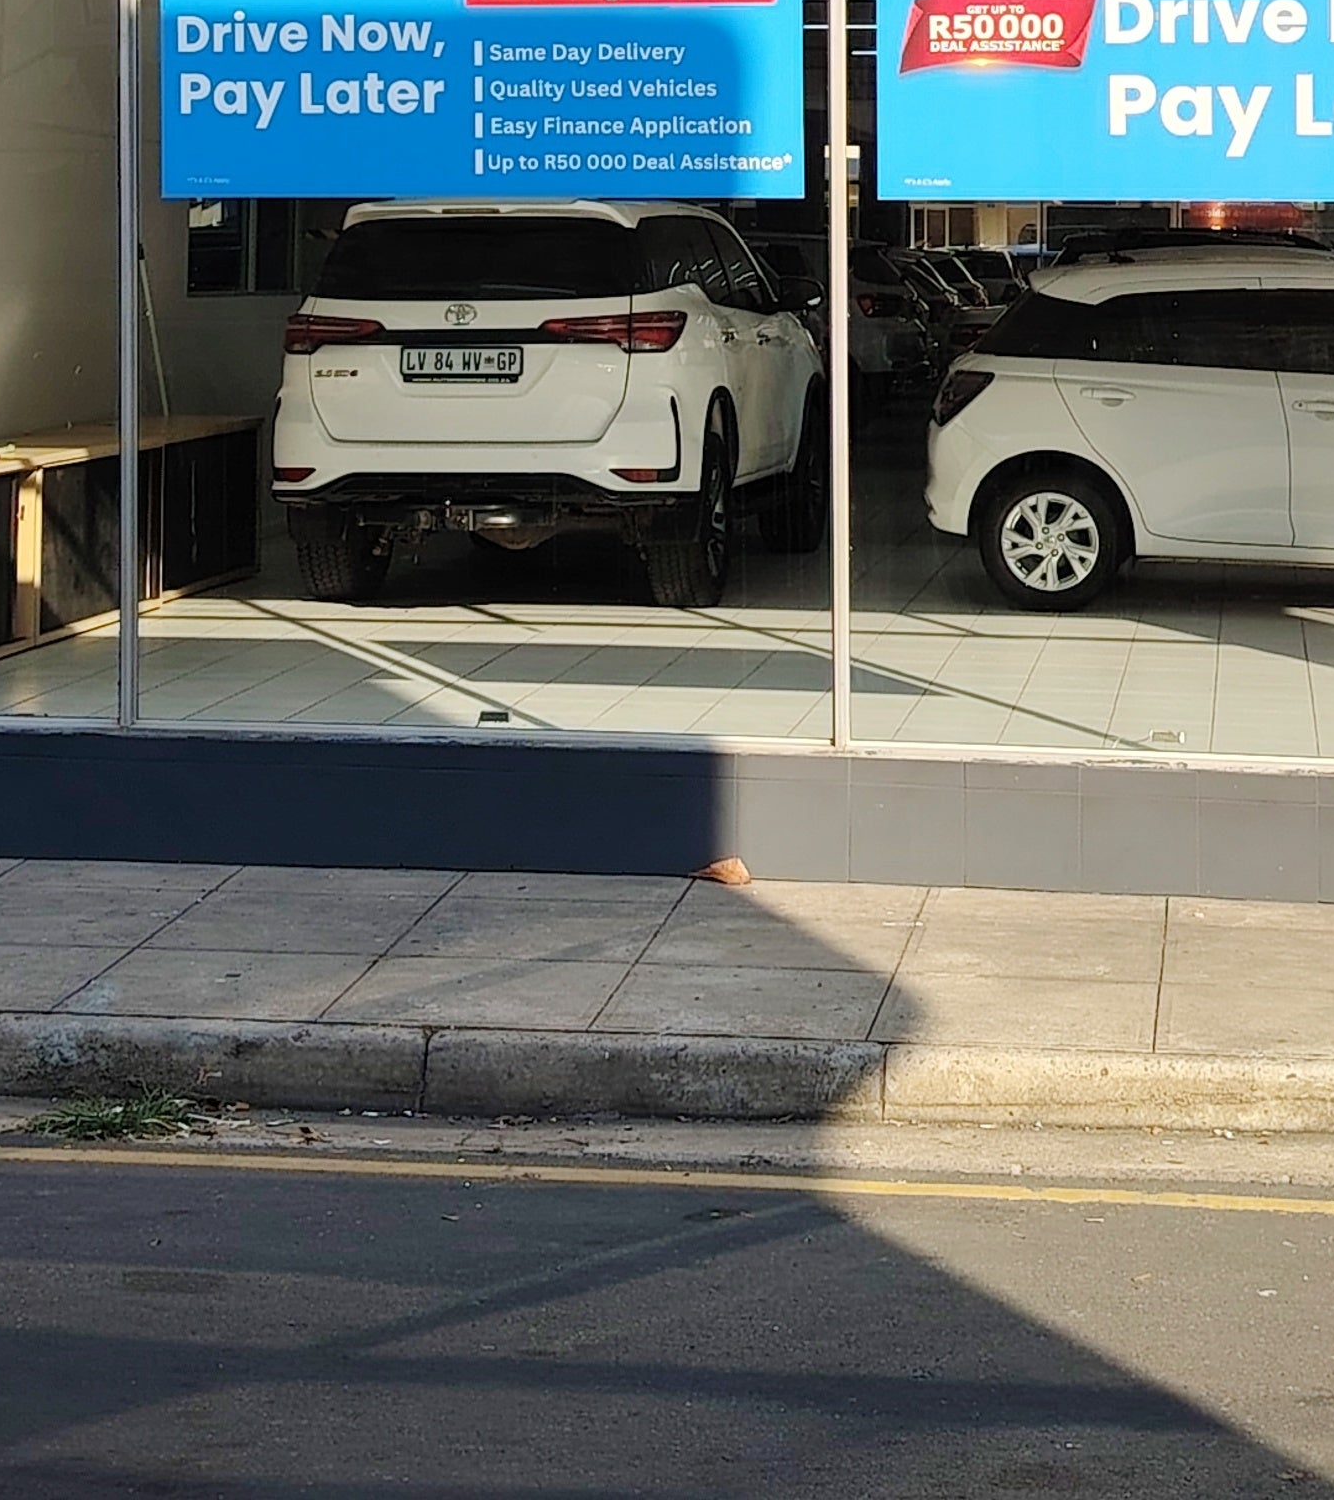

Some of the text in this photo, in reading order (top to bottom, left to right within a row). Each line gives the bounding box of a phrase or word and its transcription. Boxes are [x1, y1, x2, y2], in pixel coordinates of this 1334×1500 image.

[967, 5, 1025, 14] GET UP TO
[177, 10, 445, 58] Drive Now,
[929, 14, 1064, 39] R50 000
[489, 42, 685, 67] Same Day Delivery
[930, 41, 967, 52] DEAL
[180, 72, 444, 129] Pay Later
[490, 79, 717, 102] Quality Used Vehicles
[1108, 73, 1272, 157] Pay
[491, 116, 751, 140] Easy Finance Application
[488, 154, 513, 176] Up
[517, 155, 536, 172] to
[544, 154, 581, 172] R50
[587, 154, 626, 172] 000
[633, 153, 675, 171] Deal
[406, 352, 516, 371] LV 84 WV GP
